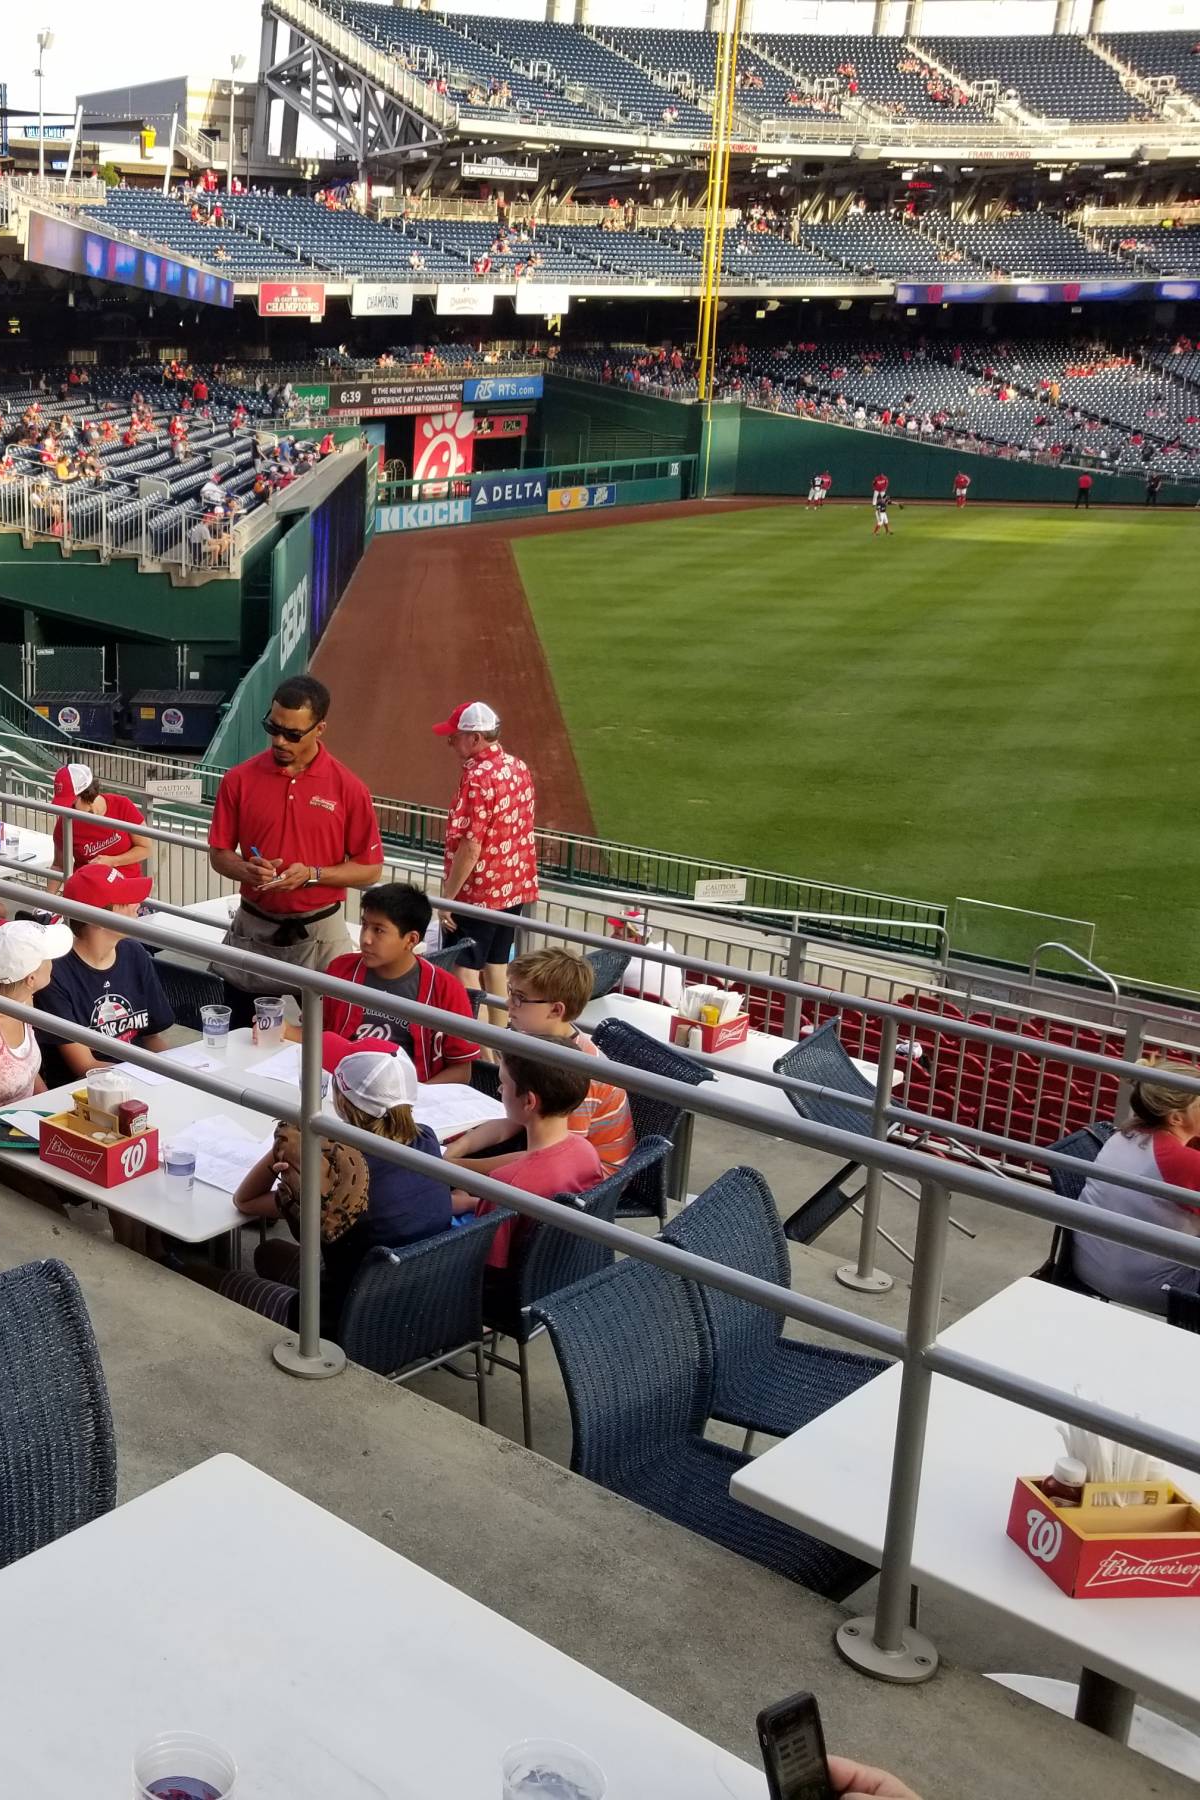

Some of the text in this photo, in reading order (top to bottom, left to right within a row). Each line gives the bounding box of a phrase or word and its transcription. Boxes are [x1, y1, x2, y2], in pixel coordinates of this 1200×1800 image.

[968, 151, 1031, 159] FRANK HOWARD
[266, 302, 320, 312] CHAMPIONS
[367, 295, 399, 310] CHAMPIONS
[403, 386, 415, 394] WAY
[424, 385, 448, 393] ENHANCE
[498, 384, 534, 397] RTS.com
[295, 392, 326, 407] eeter
[340, 391, 361, 404] 6:39
[373, 396, 406, 404] EXPERIENCE
[414, 394, 443, 402] NATIONALS
[374, 406, 403, 415] NATIONALS
[404, 405, 422, 414] DREAM
[423, 404, 453, 413] FOUNDATION
[492, 482, 543, 502] DELTA
[403, 499, 465, 529] KOCH
[280, 574, 308, 671] GEICO
[157, 784, 191, 792] CAUTION
[83, 832, 122, 856] Nationals
[705, 883, 736, 891] CAUTION
[116, 1013, 149, 1034] GAME
[51, 1137, 147, 1178] Budweiser W
[1026, 1508, 1200, 1577] W Budweiser
